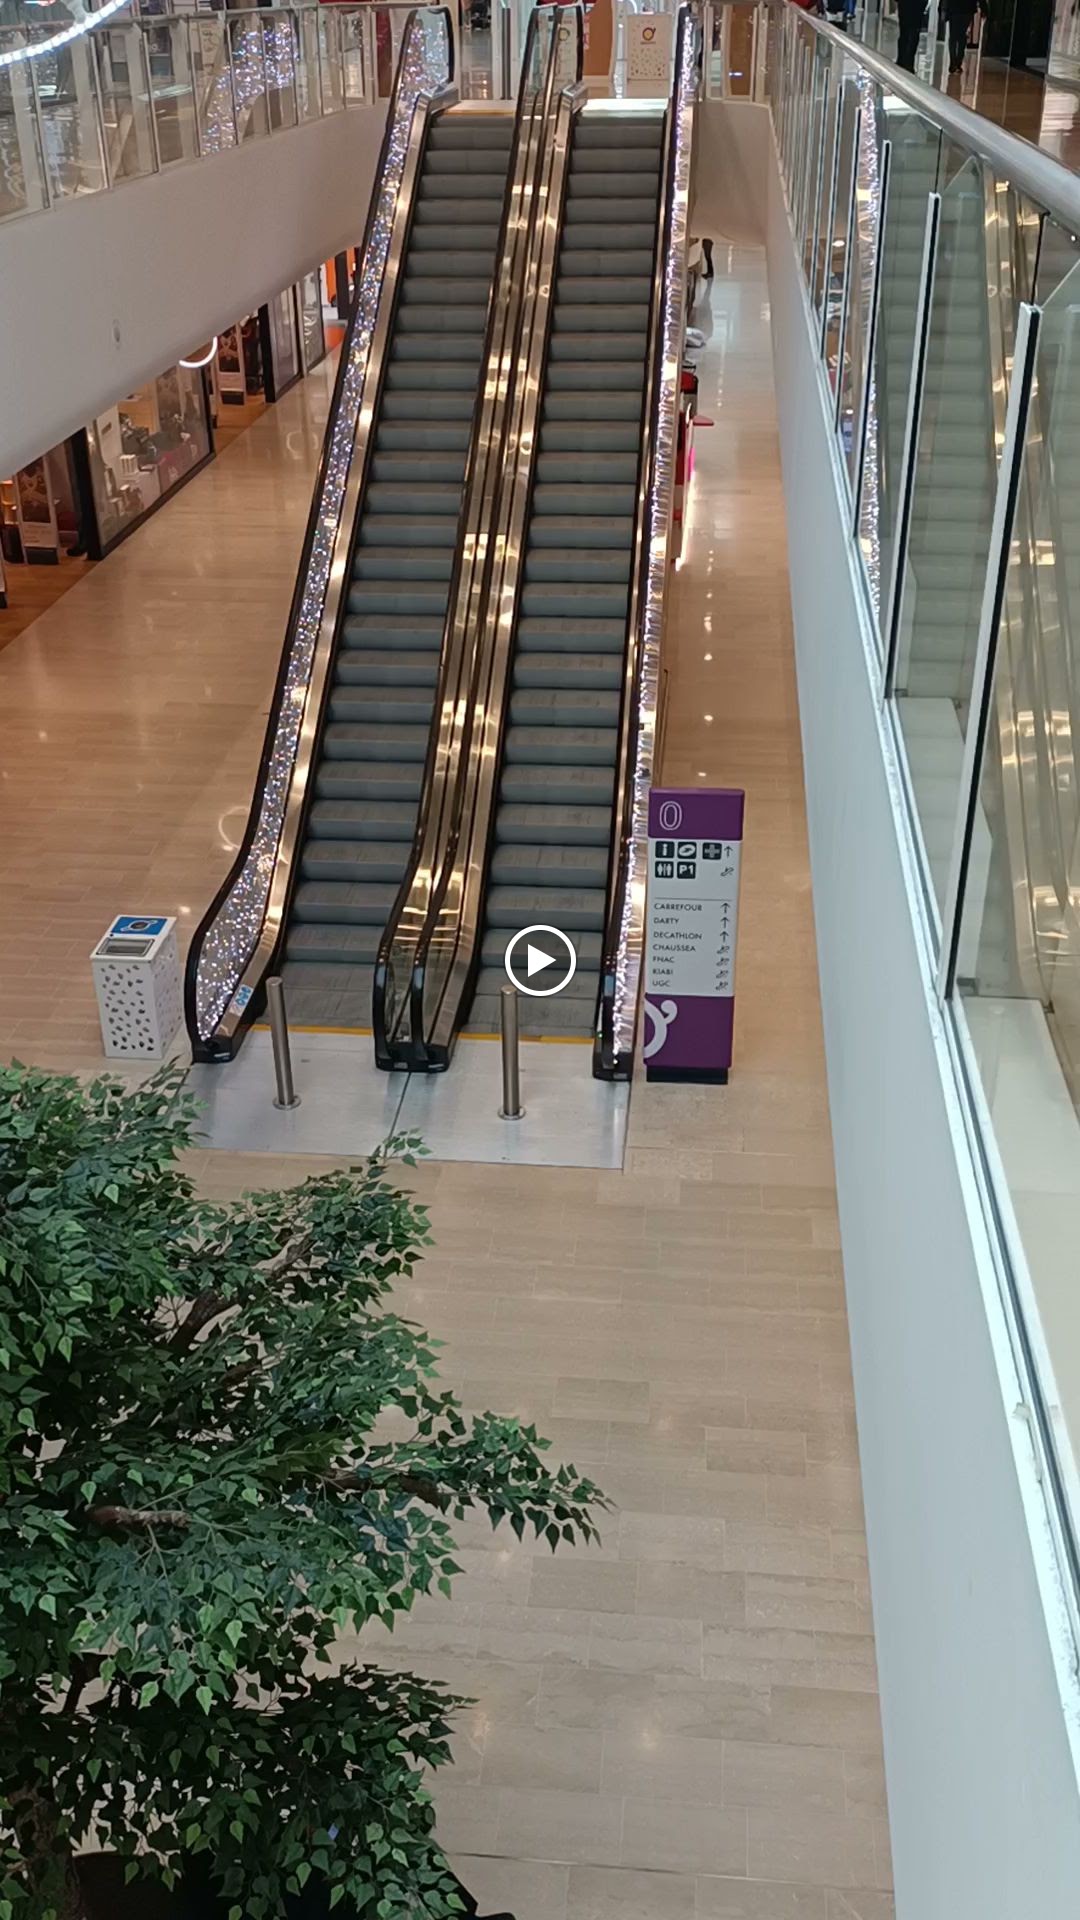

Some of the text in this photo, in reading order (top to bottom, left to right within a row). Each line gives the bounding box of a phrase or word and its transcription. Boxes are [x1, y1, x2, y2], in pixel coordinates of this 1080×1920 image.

[679, 864, 694, 875] P1
[654, 903, 703, 911] CARREFOUR
[653, 931, 702, 940] DECATHLON
[652, 944, 696, 952] CHAUSSEA
